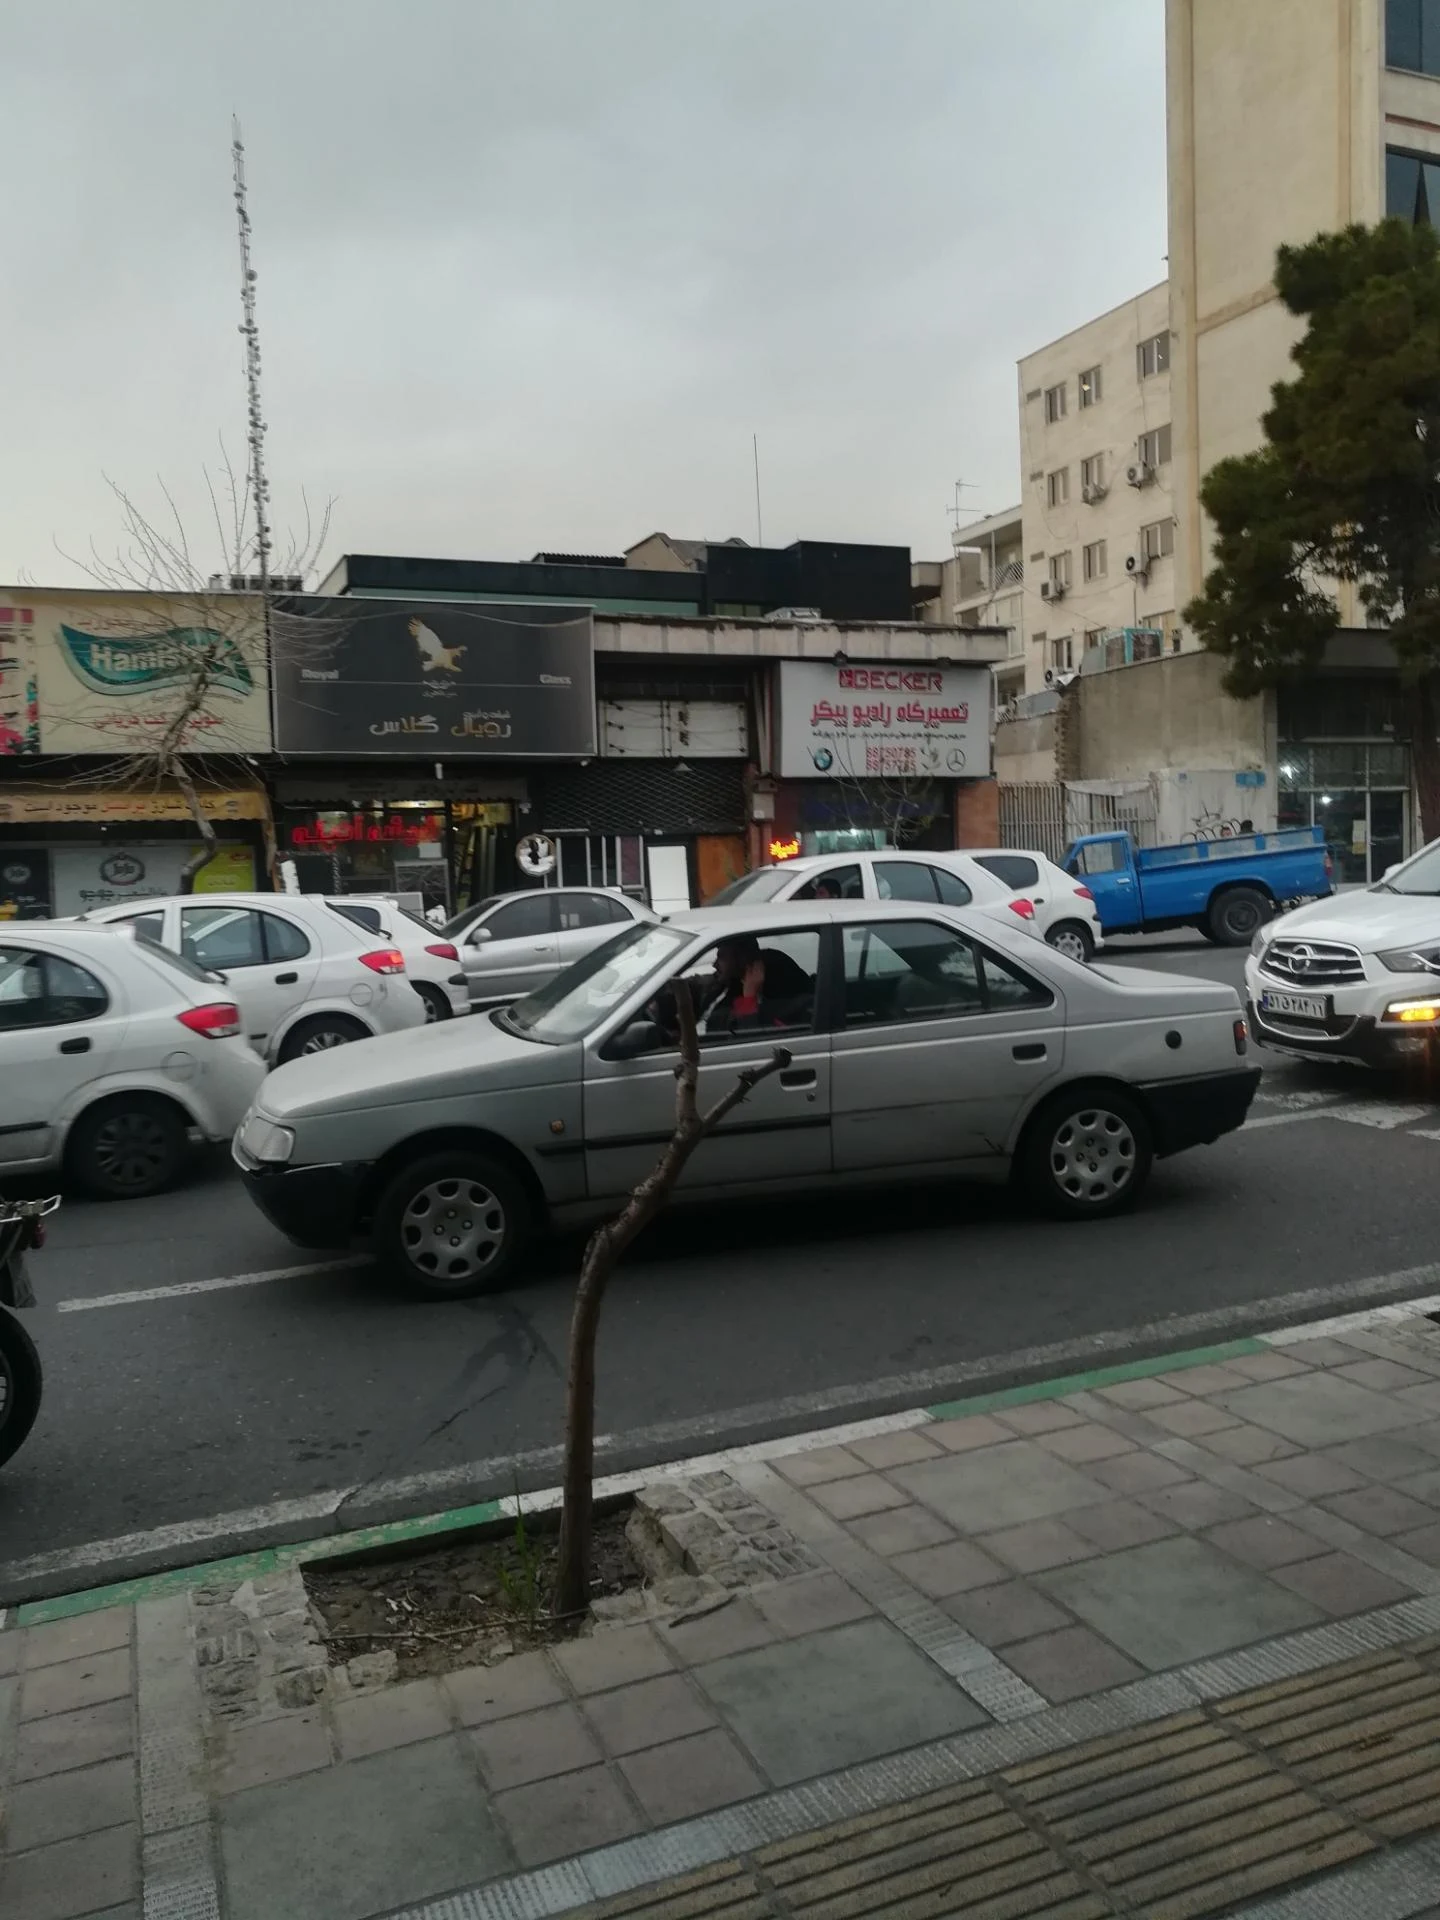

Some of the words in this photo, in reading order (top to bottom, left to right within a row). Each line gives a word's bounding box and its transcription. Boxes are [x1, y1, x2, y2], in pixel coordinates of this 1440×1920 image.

[853, 668, 943, 692] BECKER
[369, 713, 440, 737] گلاس
[852, 702, 891, 728] رادیو
[896, 700, 969, 729] تعمیرگاه
[451, 716, 512, 738] رویال
